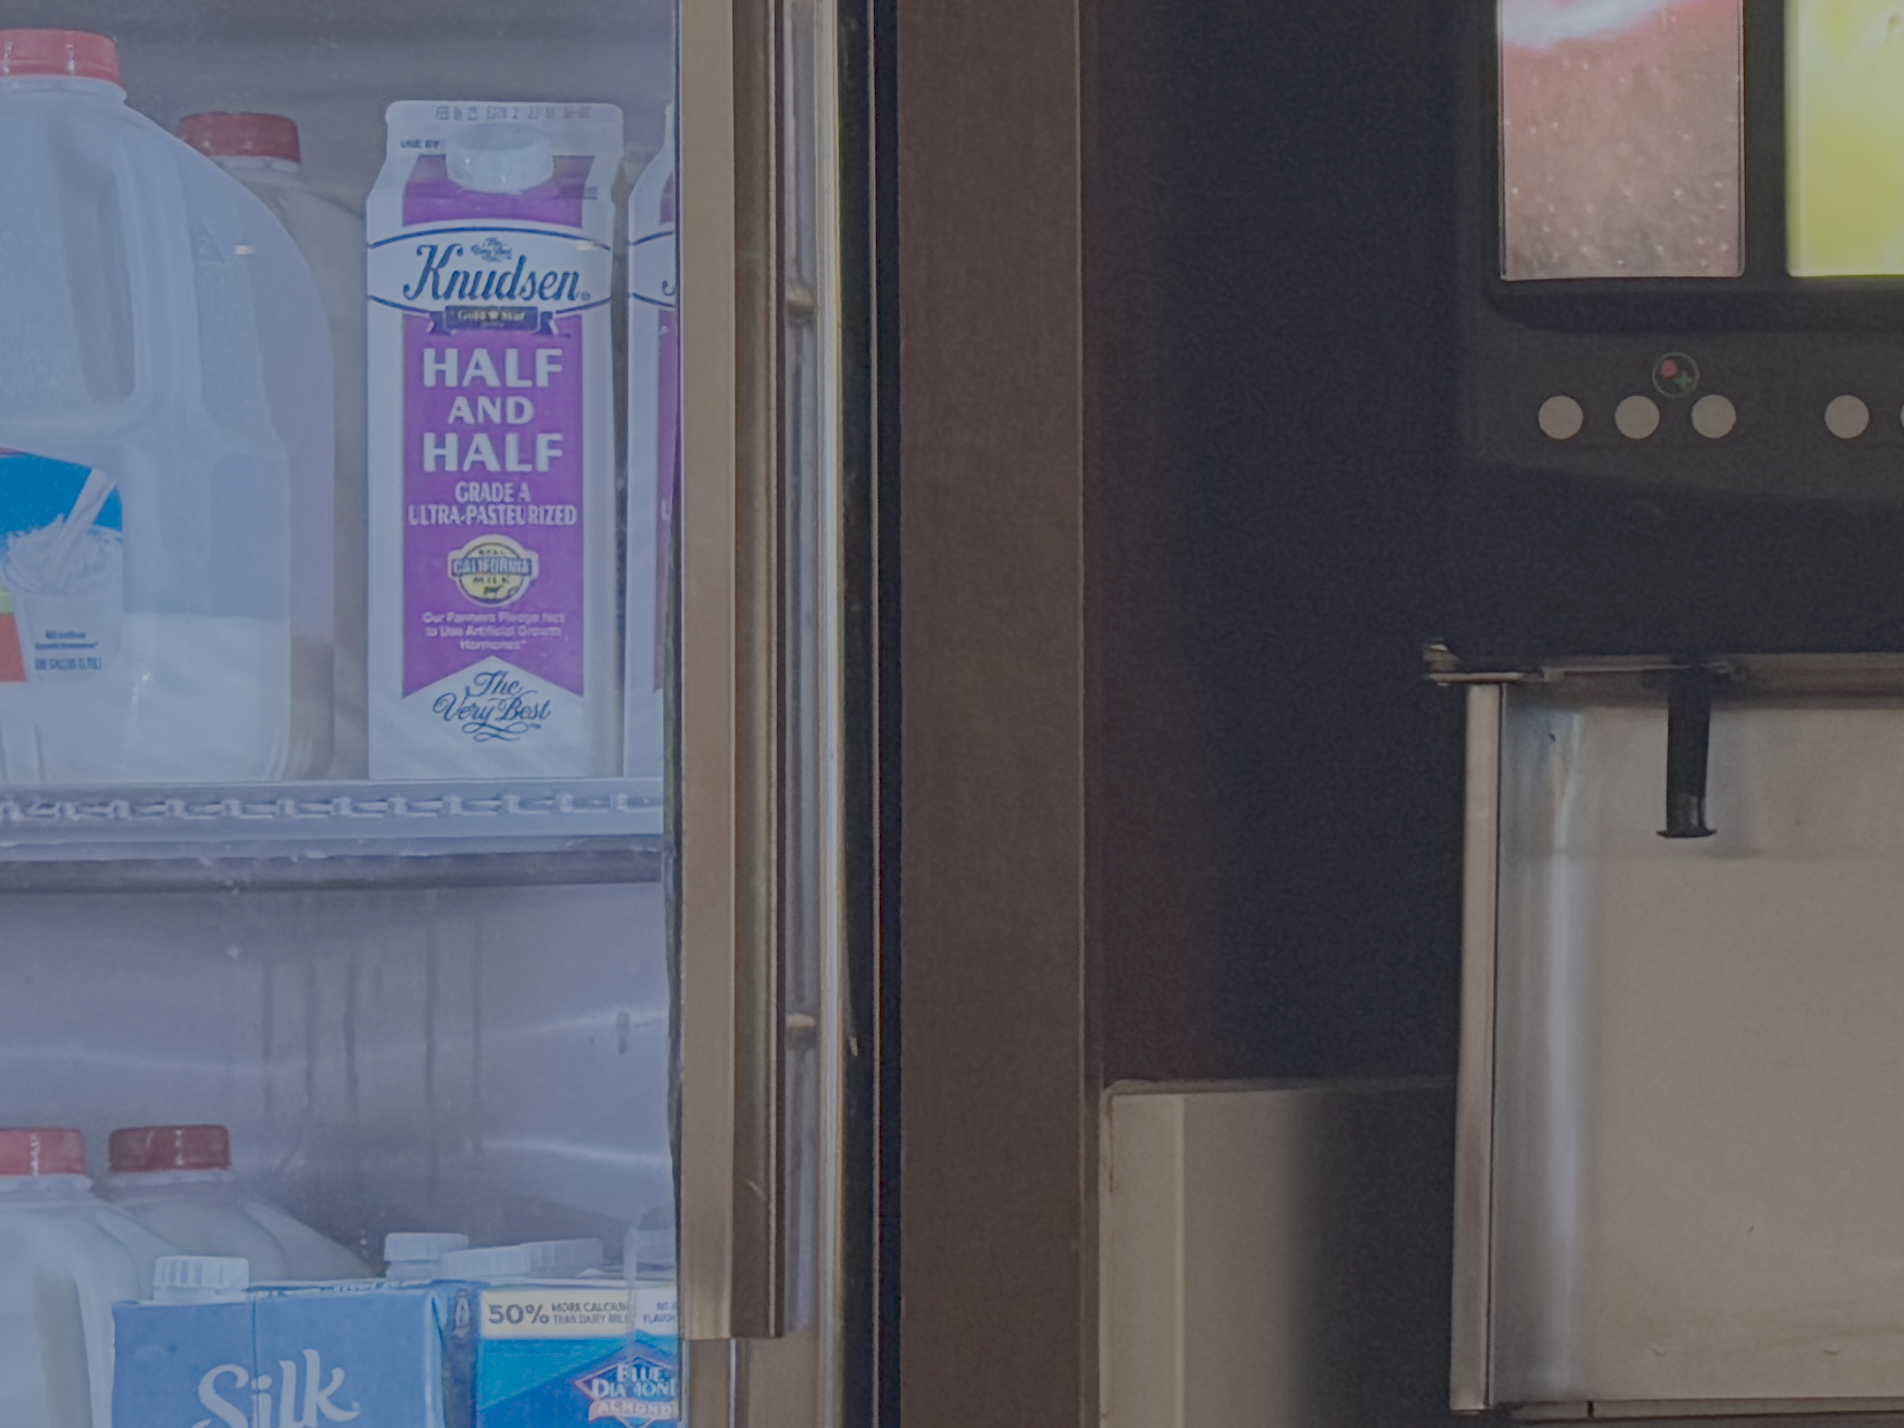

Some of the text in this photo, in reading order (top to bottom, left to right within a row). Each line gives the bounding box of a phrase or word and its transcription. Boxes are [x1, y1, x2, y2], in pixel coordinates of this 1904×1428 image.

[402, 242, 582, 302] Knudsen
[423, 347, 564, 389] HALF
[446, 395, 536, 425] AND
[423, 432, 565, 473] HALF
[454, 480, 532, 503] GRADE A
[408, 503, 579, 526] ULTRA-PASTEURIZED
[473, 669, 523, 697] The
[432, 691, 552, 723] Very Best
[488, 1303, 550, 1325] 50%
